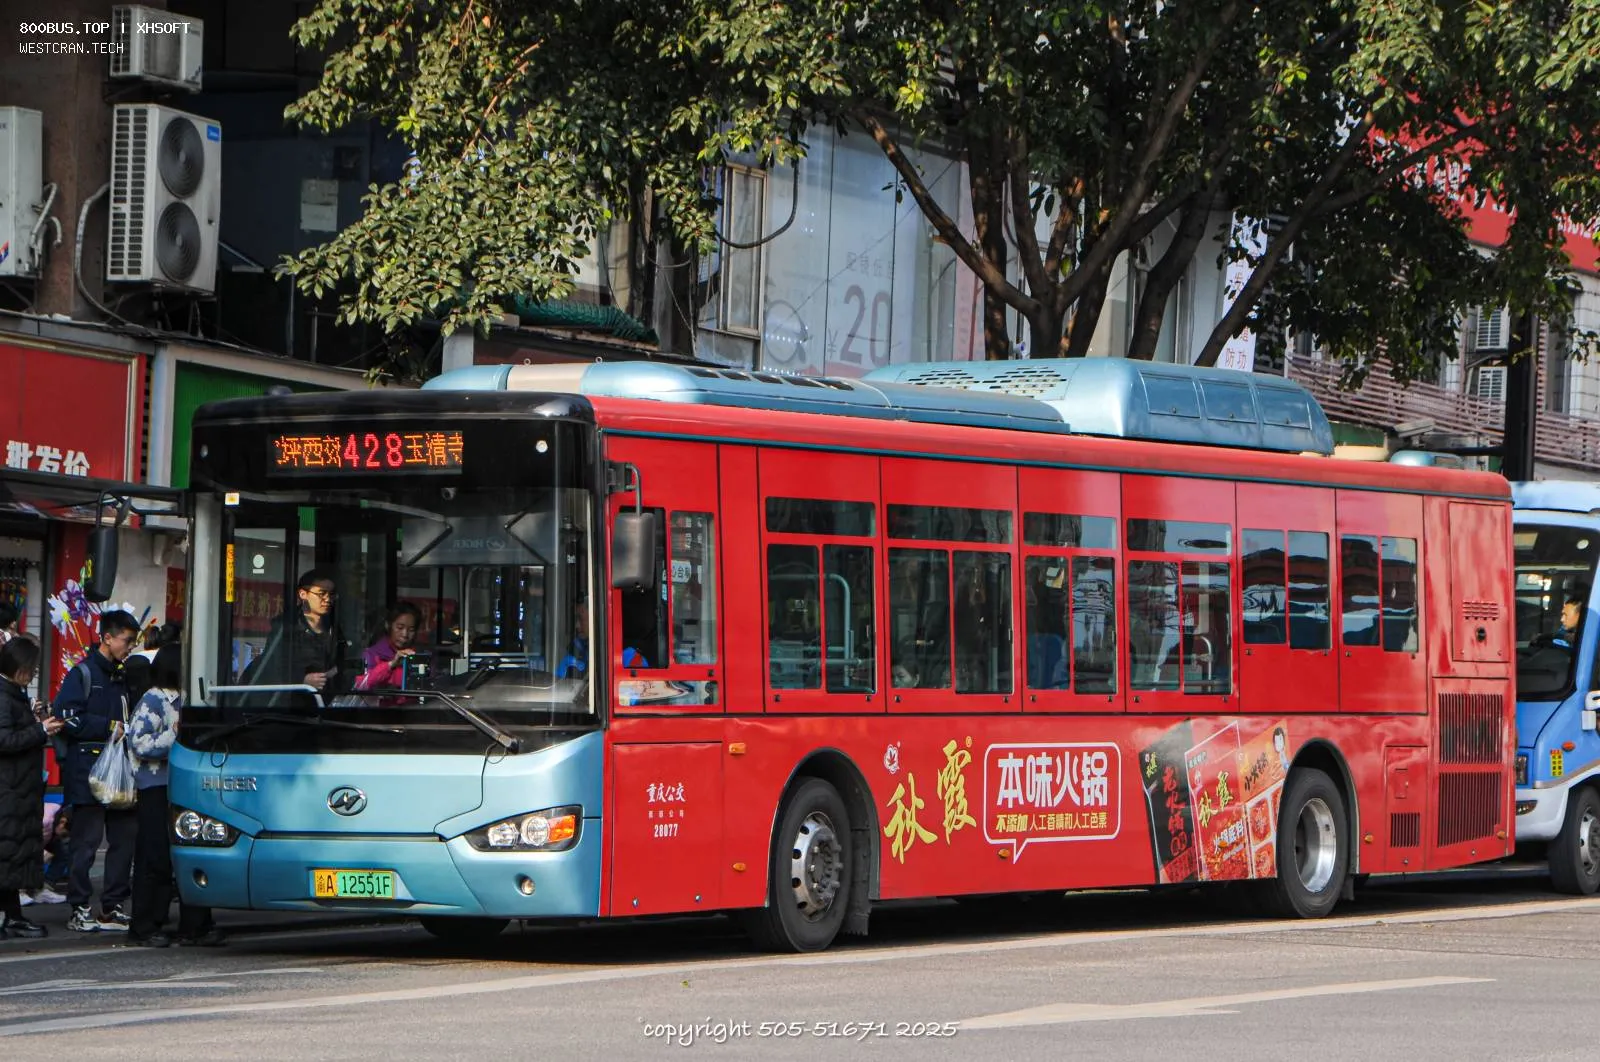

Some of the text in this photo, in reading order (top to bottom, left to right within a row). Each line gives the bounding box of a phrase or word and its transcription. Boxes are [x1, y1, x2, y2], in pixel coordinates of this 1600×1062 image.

[6, 440, 90, 477] 批发价
[343, 433, 403, 468] 428
[201, 775, 258, 792] HIGER
[996, 751, 1108, 808] 本味火锅
[646, 782, 687, 803] 重庆公交
[653, 822, 679, 838] 28077
[996, 811, 1108, 834] 不添加 人工香精和人工色素
